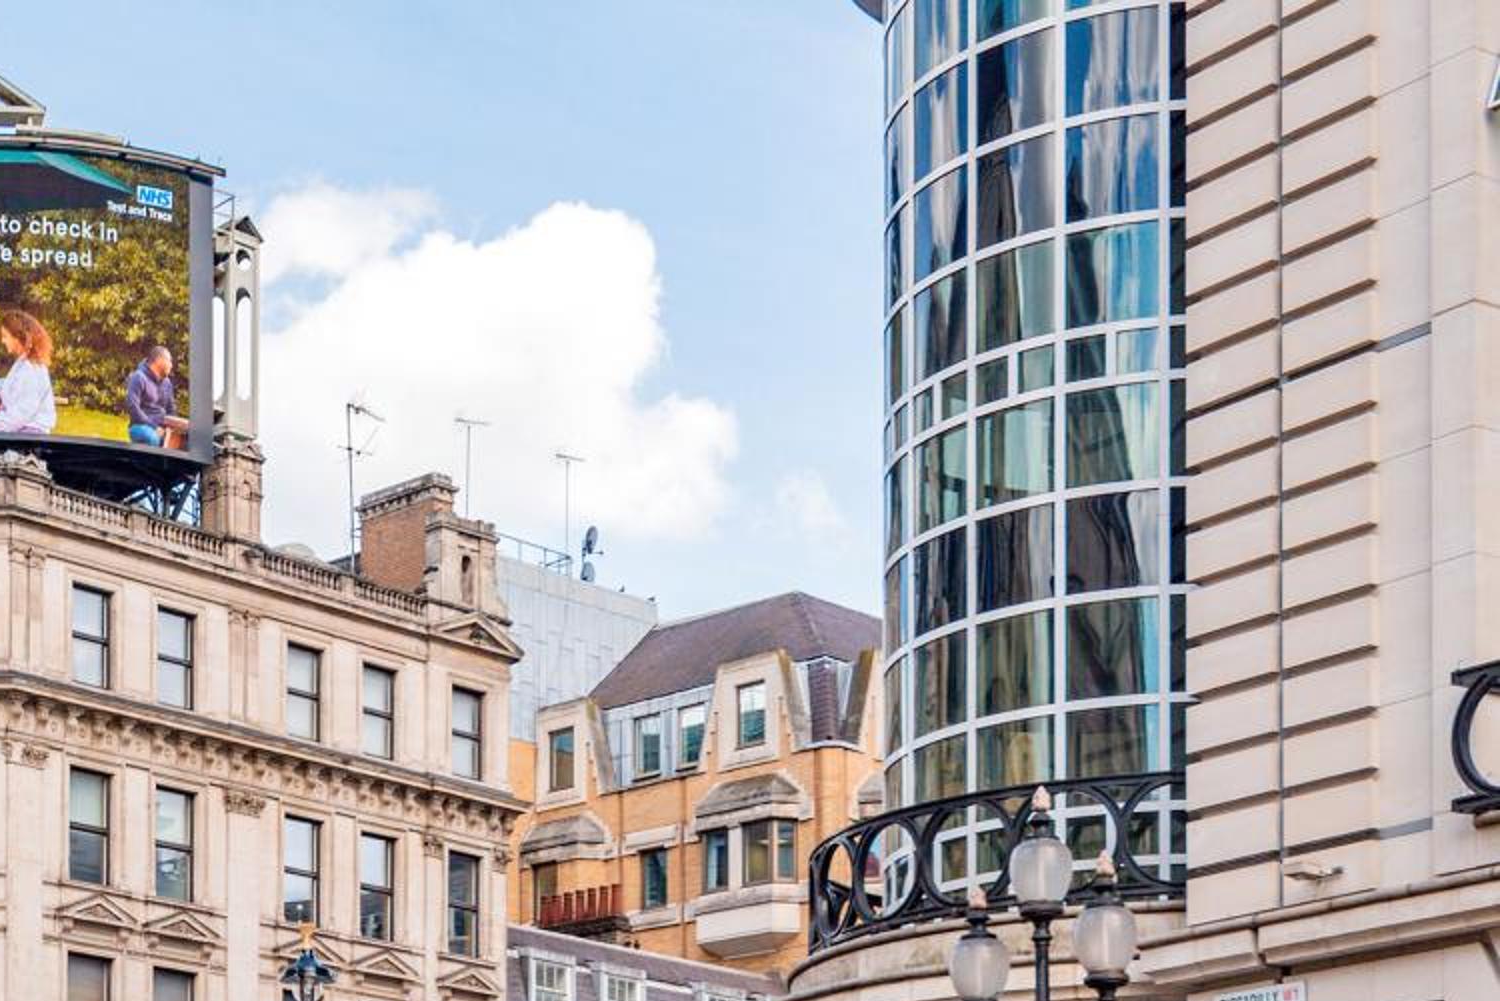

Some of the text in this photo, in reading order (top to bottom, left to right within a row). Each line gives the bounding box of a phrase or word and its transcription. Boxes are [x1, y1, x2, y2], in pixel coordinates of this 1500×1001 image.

[140, 187, 171, 206] NHS
[0, 216, 21, 233] to
[28, 216, 93, 240] check
[100, 222, 118, 242] in
[19, 248, 93, 270] spread
